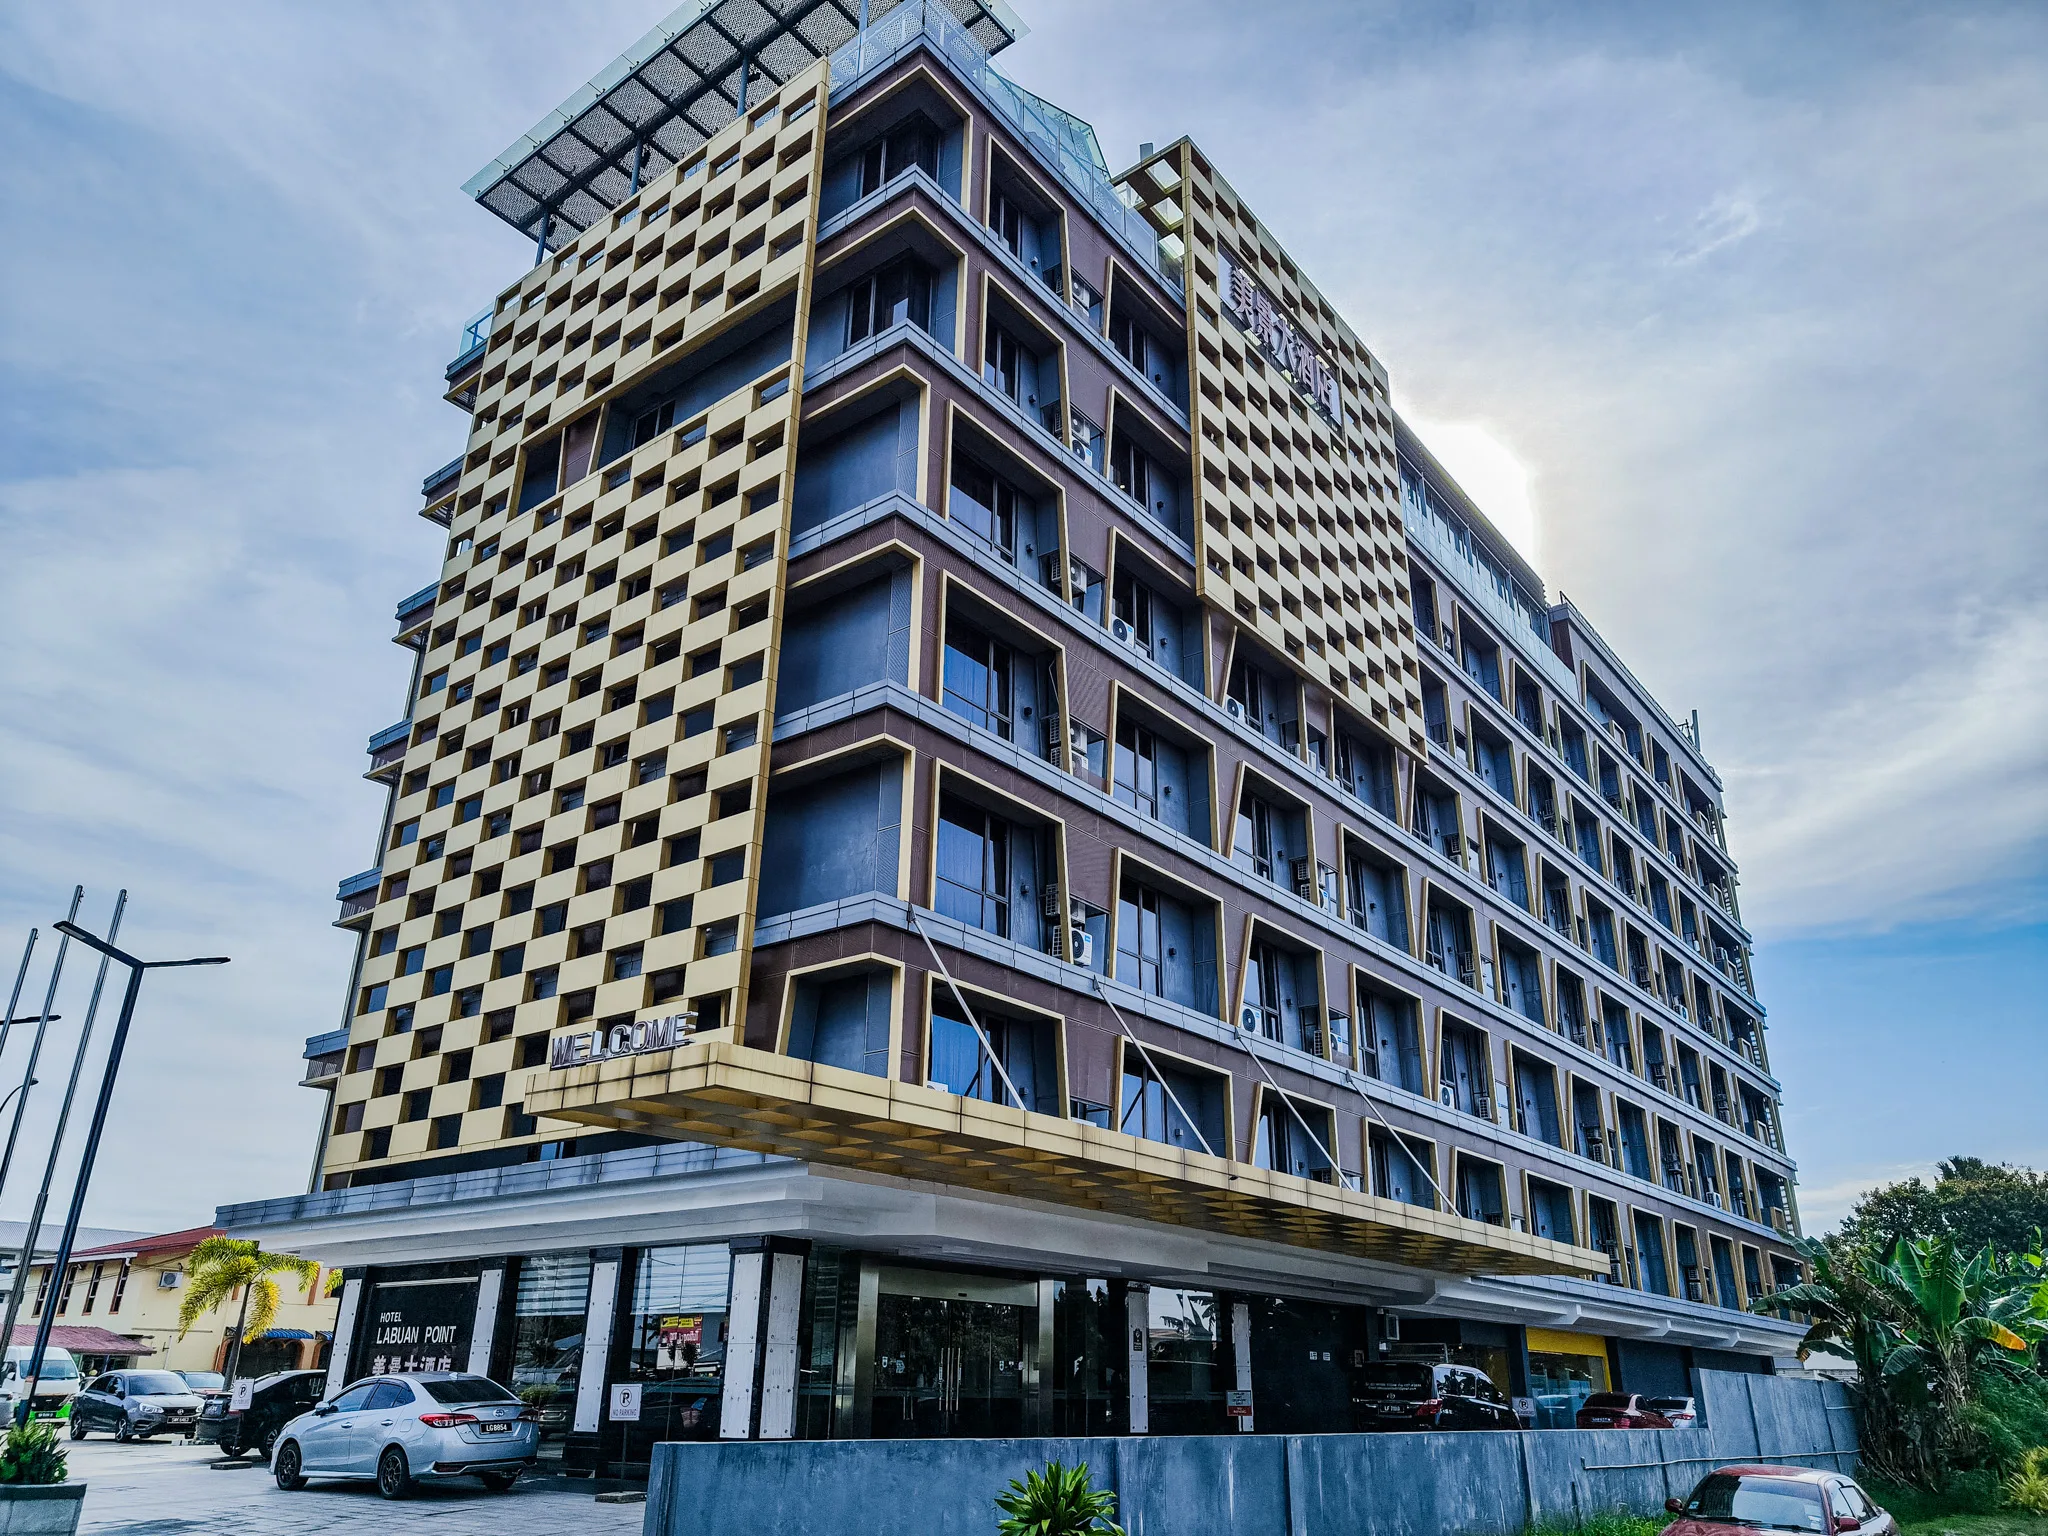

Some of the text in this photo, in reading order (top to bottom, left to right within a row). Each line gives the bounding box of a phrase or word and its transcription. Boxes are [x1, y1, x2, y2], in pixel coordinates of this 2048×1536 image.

[1230, 265, 1332, 415] 美景大酒店
[552, 1011, 698, 1068] WELCOME
[376, 1325, 457, 1344] LABUAN POINT
[380, 1312, 402, 1323] HOTEL
